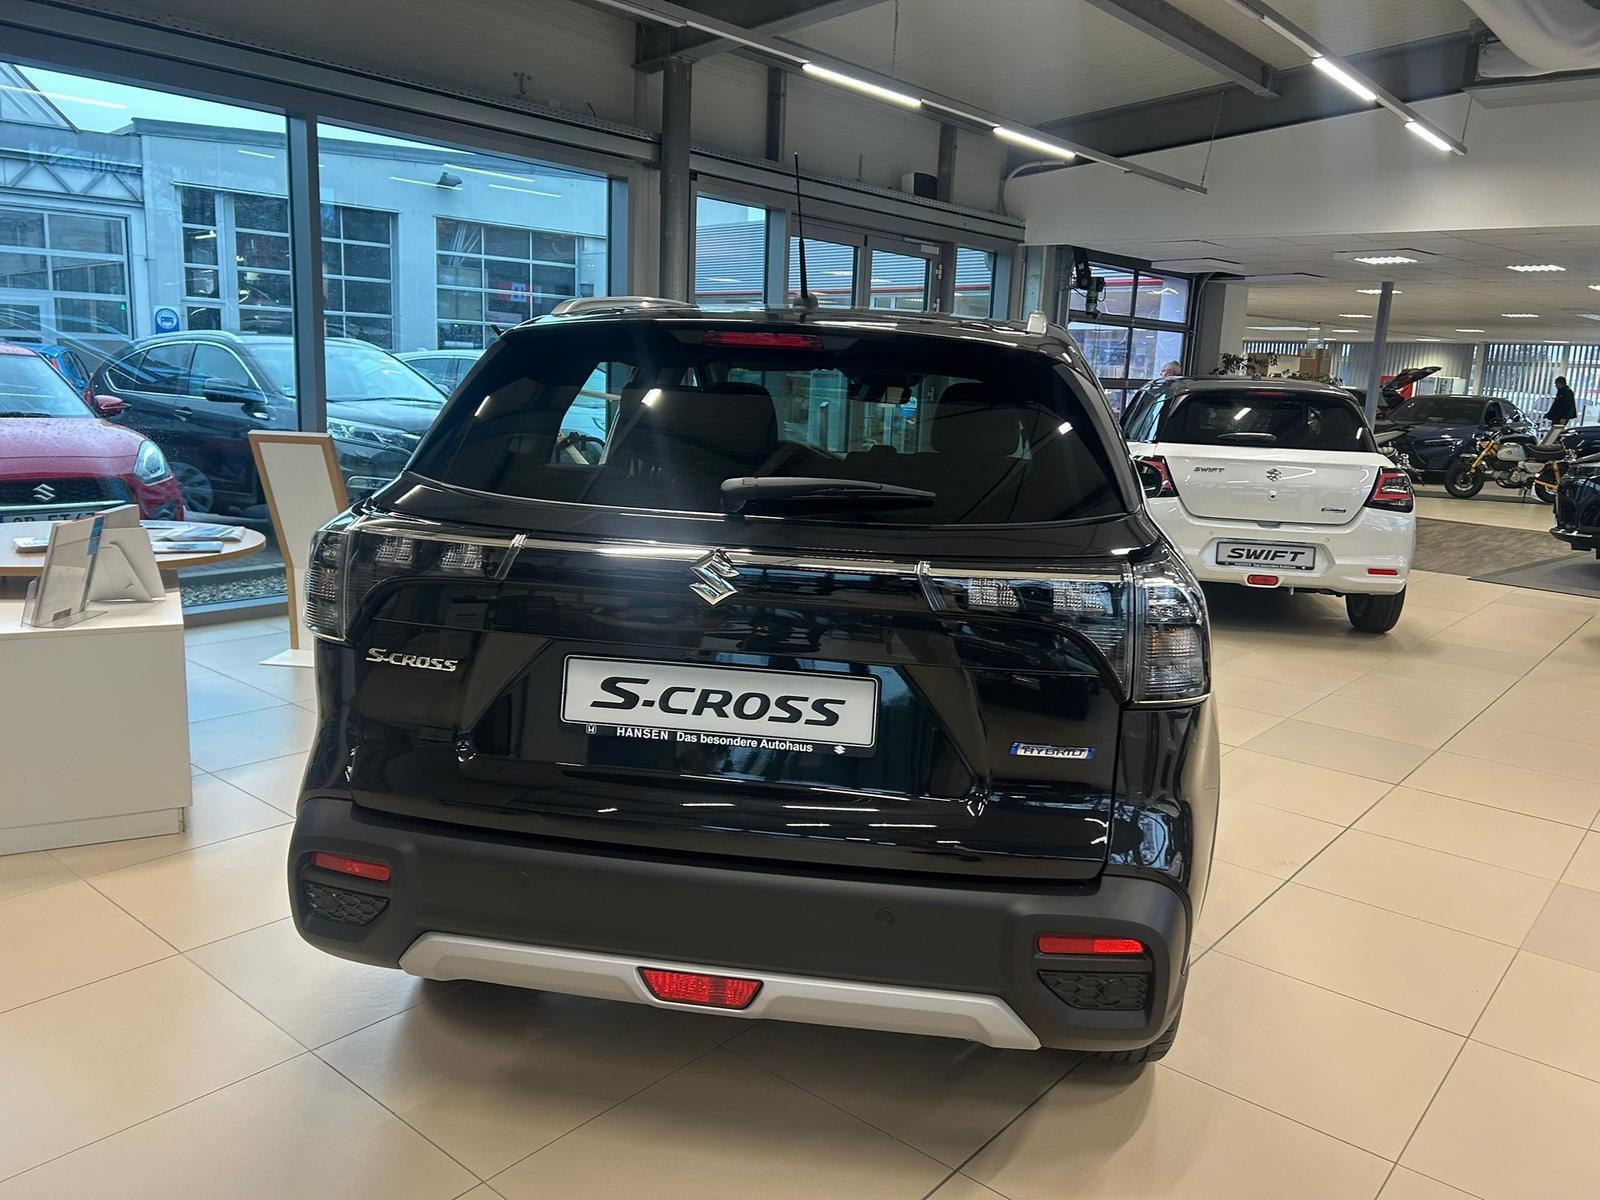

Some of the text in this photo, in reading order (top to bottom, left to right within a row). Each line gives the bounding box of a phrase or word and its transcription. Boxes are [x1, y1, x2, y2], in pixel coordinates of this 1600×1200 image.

[1226, 548, 1306, 562] SWIFT
[365, 647, 459, 672] S-CROSS
[590, 676, 846, 727] S-CROSS
[616, 726, 814, 753] HANSEN Das besondere Autohaus
[1021, 745, 1086, 757] HYBRID
